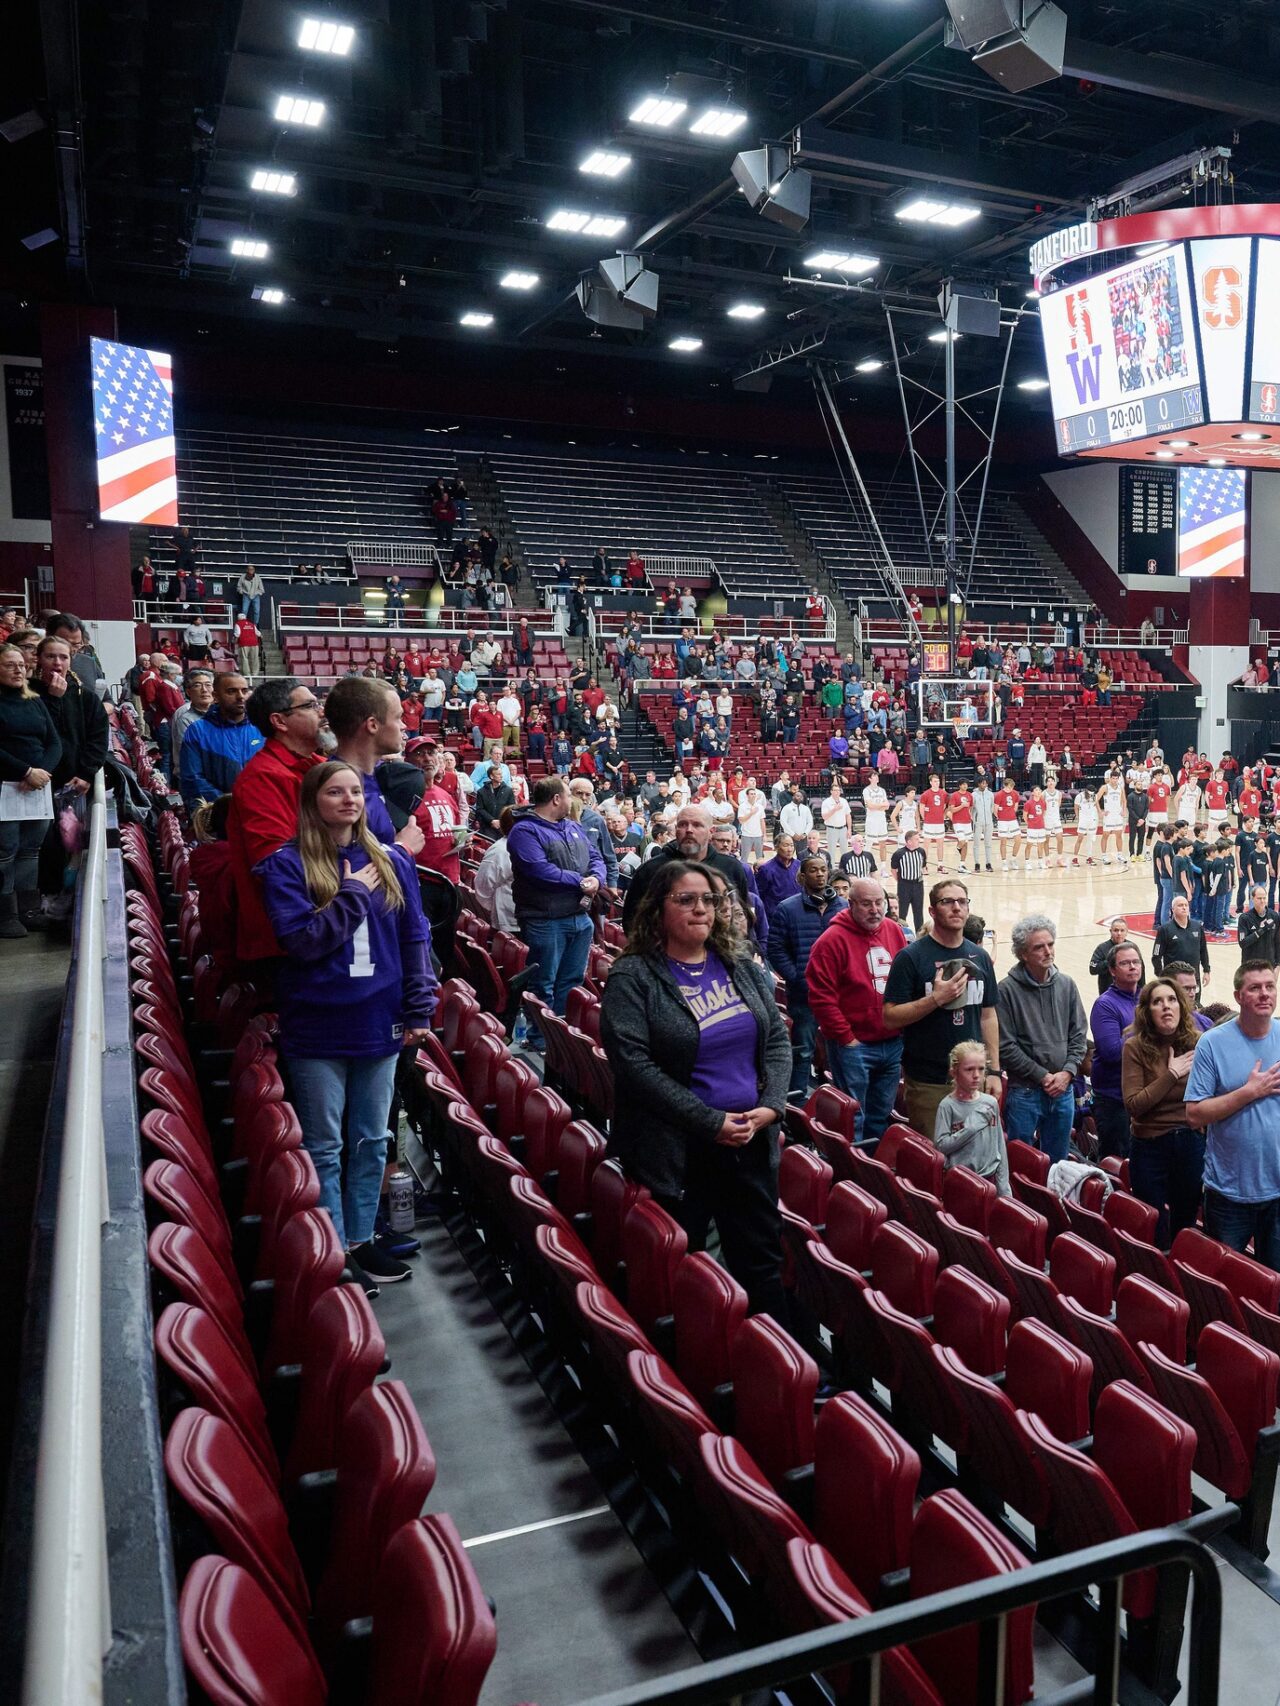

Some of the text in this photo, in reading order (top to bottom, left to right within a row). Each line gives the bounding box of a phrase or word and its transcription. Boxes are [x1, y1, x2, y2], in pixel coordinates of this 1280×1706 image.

[1029, 222, 1096, 274] STANFORD
[1066, 345, 1102, 405] W
[14, 388, 33, 396] 1937
[1087, 398, 1168, 436] 0 20:00 0
[924, 644, 948, 653] 20:00
[928, 654, 945, 670] 30
[1158, 787, 1165, 798] S
[1216, 785, 1224, 795] S
[934, 794, 941, 806] S
[1006, 795, 1013, 806] S
[1035, 804, 1042, 815] S
[349, 915, 376, 977] 1
[866, 946, 892, 995] S
[681, 976, 740, 1021] uski
